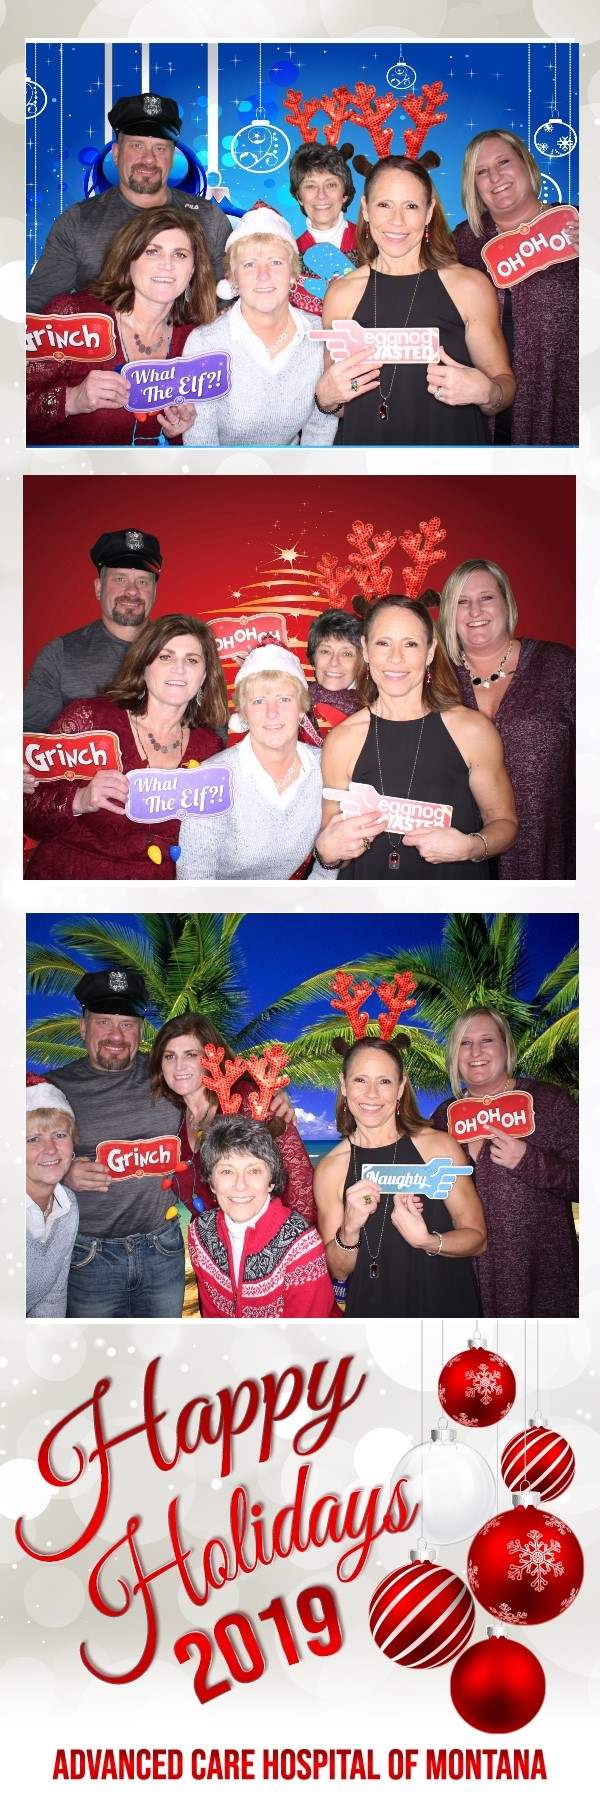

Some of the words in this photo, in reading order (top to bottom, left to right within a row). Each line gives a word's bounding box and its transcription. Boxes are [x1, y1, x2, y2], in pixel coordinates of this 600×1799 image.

[363, 331, 433, 348] eggnog
[131, 367, 176, 385] What
[142, 386, 173, 403] The
[179, 370, 222, 397] Elf?!
[25, 742, 107, 772] Grinch
[134, 777, 178, 793] What
[145, 795, 175, 813] The
[181, 785, 225, 812] Elf?!
[378, 799, 445, 822] eggnog
[107, 1145, 171, 1172] Grinch
[366, 1170, 432, 1189] Naughty
